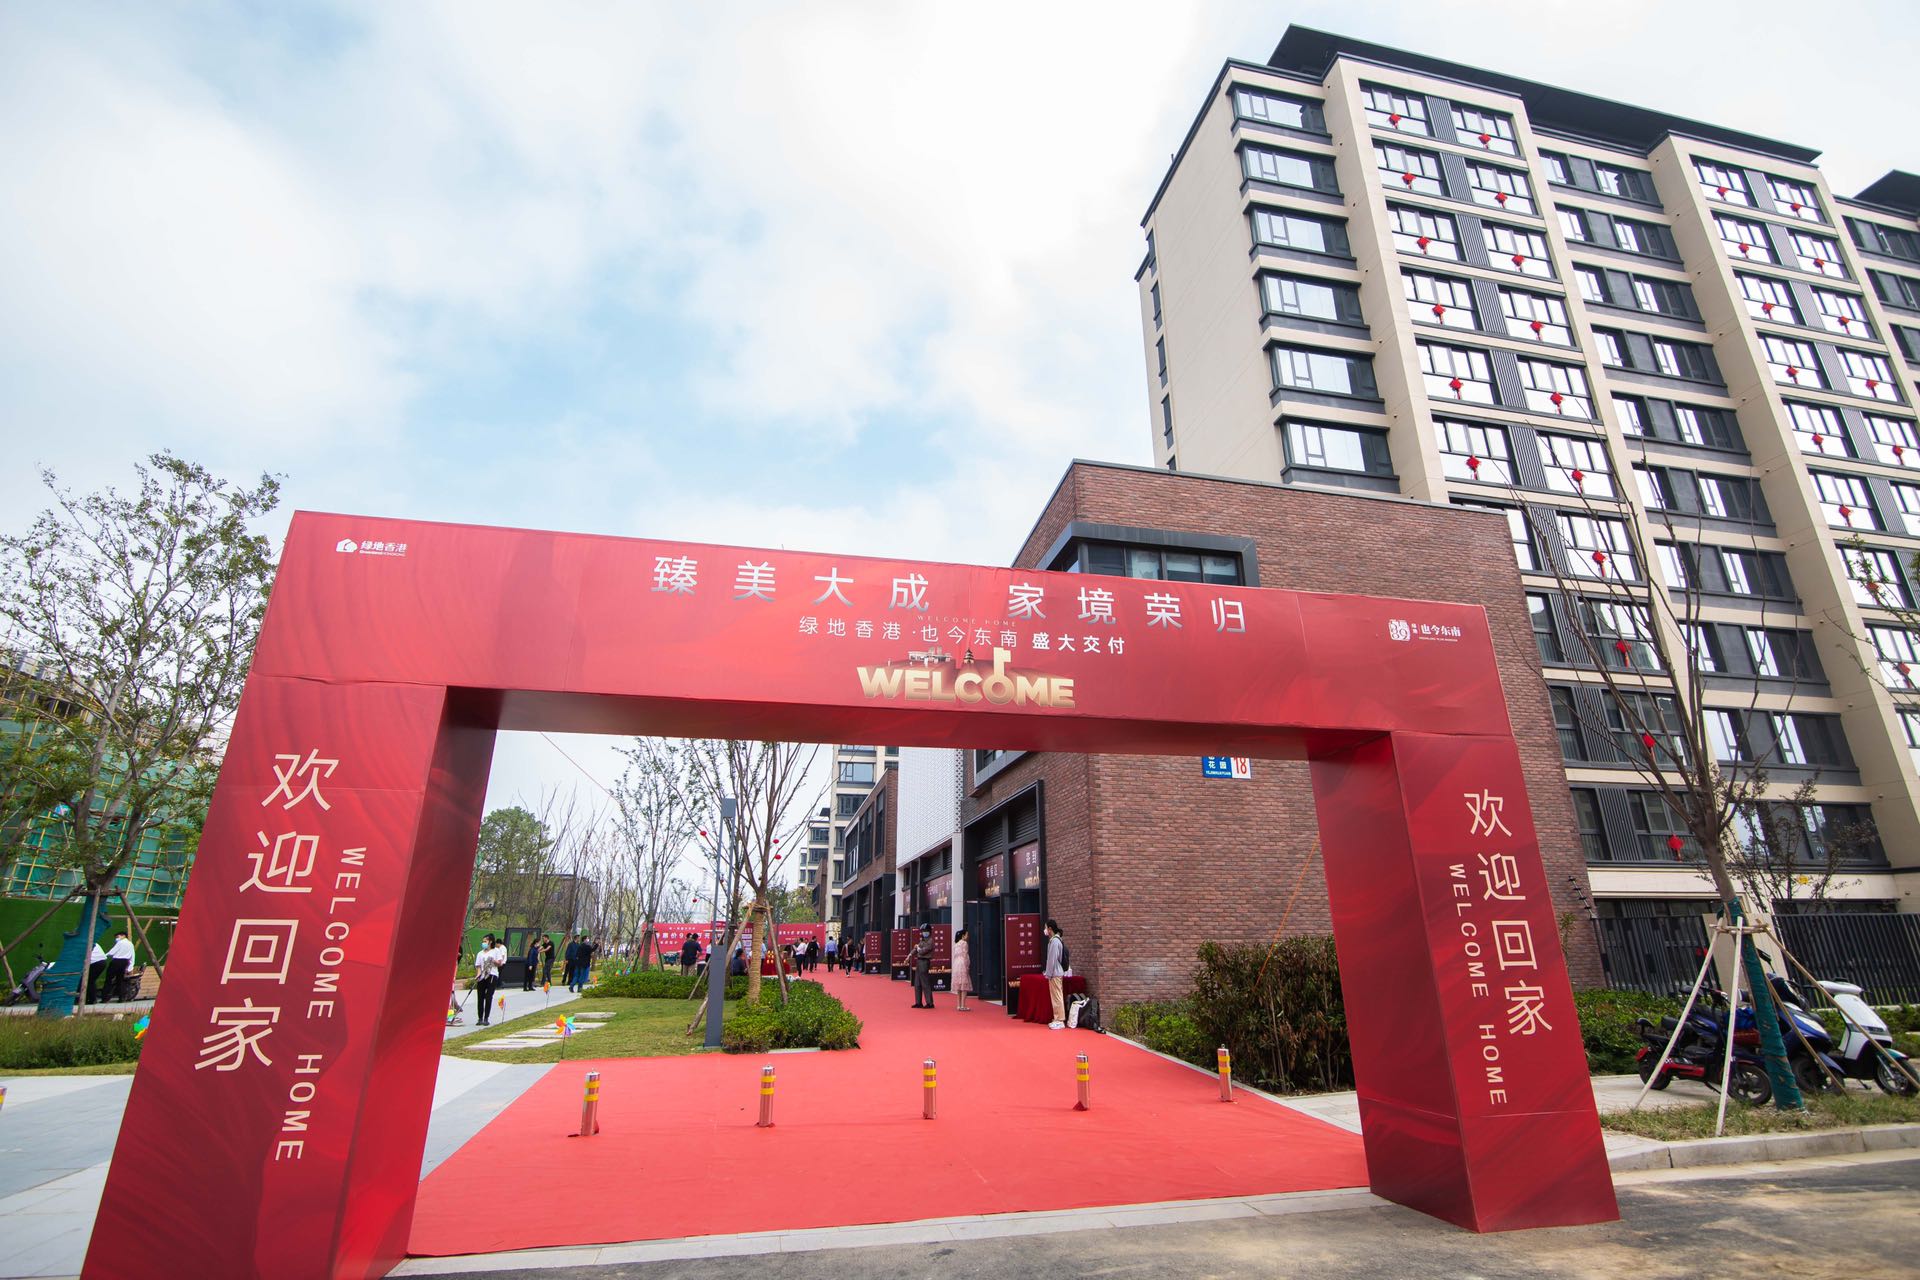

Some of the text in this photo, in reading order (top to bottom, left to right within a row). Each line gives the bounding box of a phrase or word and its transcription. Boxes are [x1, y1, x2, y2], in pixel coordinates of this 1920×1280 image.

[360, 540, 407, 553] 绿地香港
[651, 556, 1247, 634] 臻美大成 家境荣归
[916, 614, 977, 626] WELCOME
[856, 647, 1077, 708] WELCOME
[1032, 631, 1126, 656] 盛大交付
[194, 748, 340, 1073] 欢迎回家
[1463, 788, 1553, 1037] 欢迎回家
[274, 846, 368, 1162] WELCOME HOME
[1448, 863, 1508, 1106] WELCOME HOME
